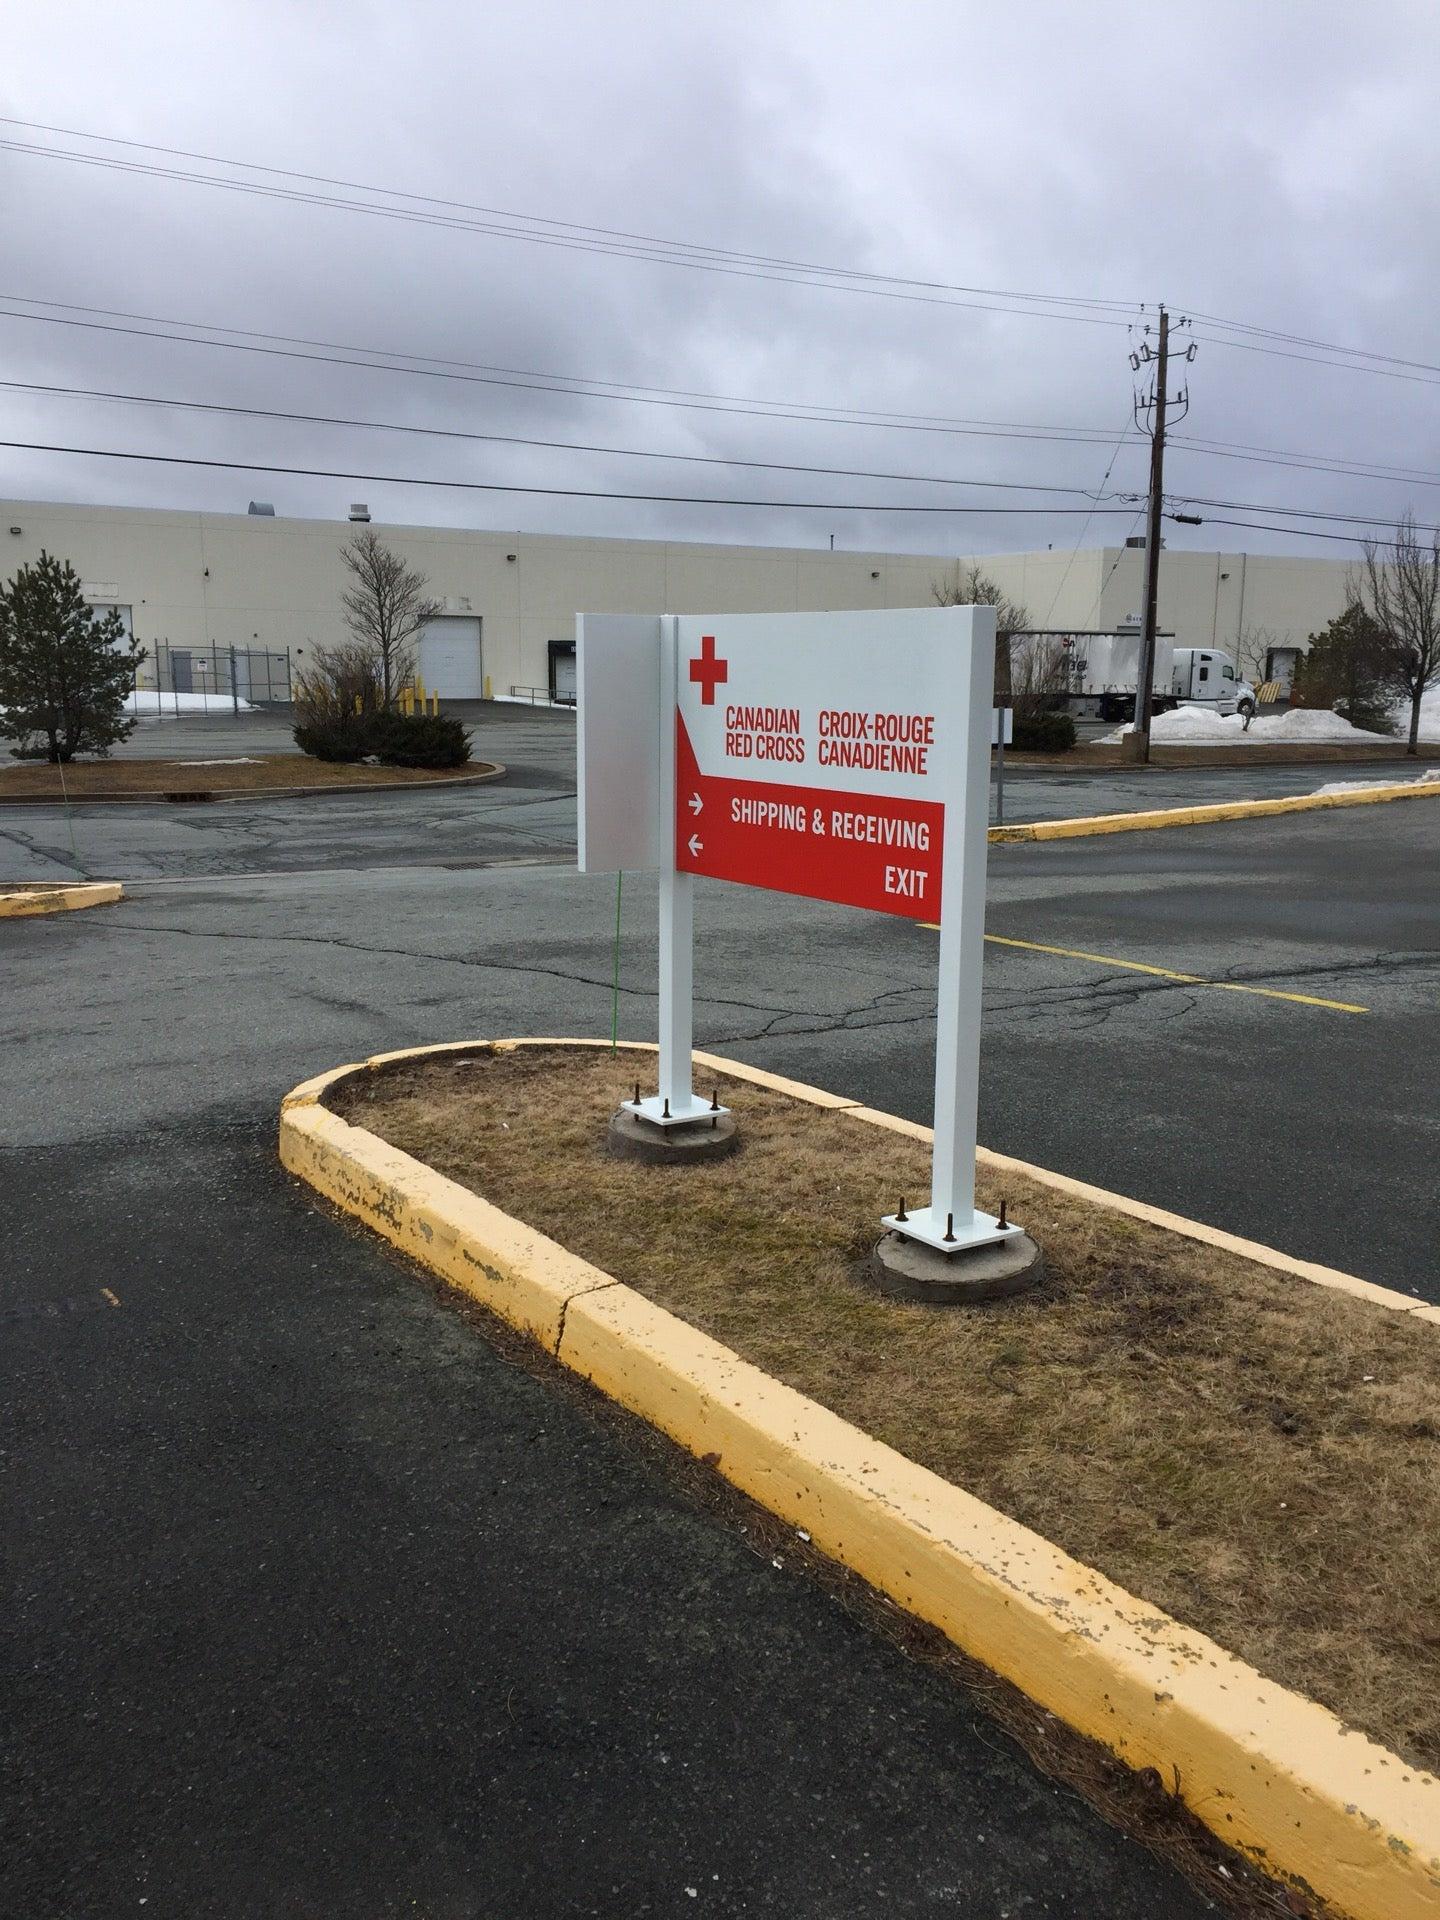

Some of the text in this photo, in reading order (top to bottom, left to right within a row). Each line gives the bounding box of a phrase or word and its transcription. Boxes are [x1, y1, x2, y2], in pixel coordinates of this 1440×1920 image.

[726, 705, 800, 734] CANADIAN
[819, 710, 934, 745] CROIX-ROUGE
[726, 733, 805, 763] RED CROSS
[818, 740, 928, 775] CANADIENNE
[731, 797, 930, 852] SHIPPING & RECEIVING
[885, 865, 928, 899] EXIT
